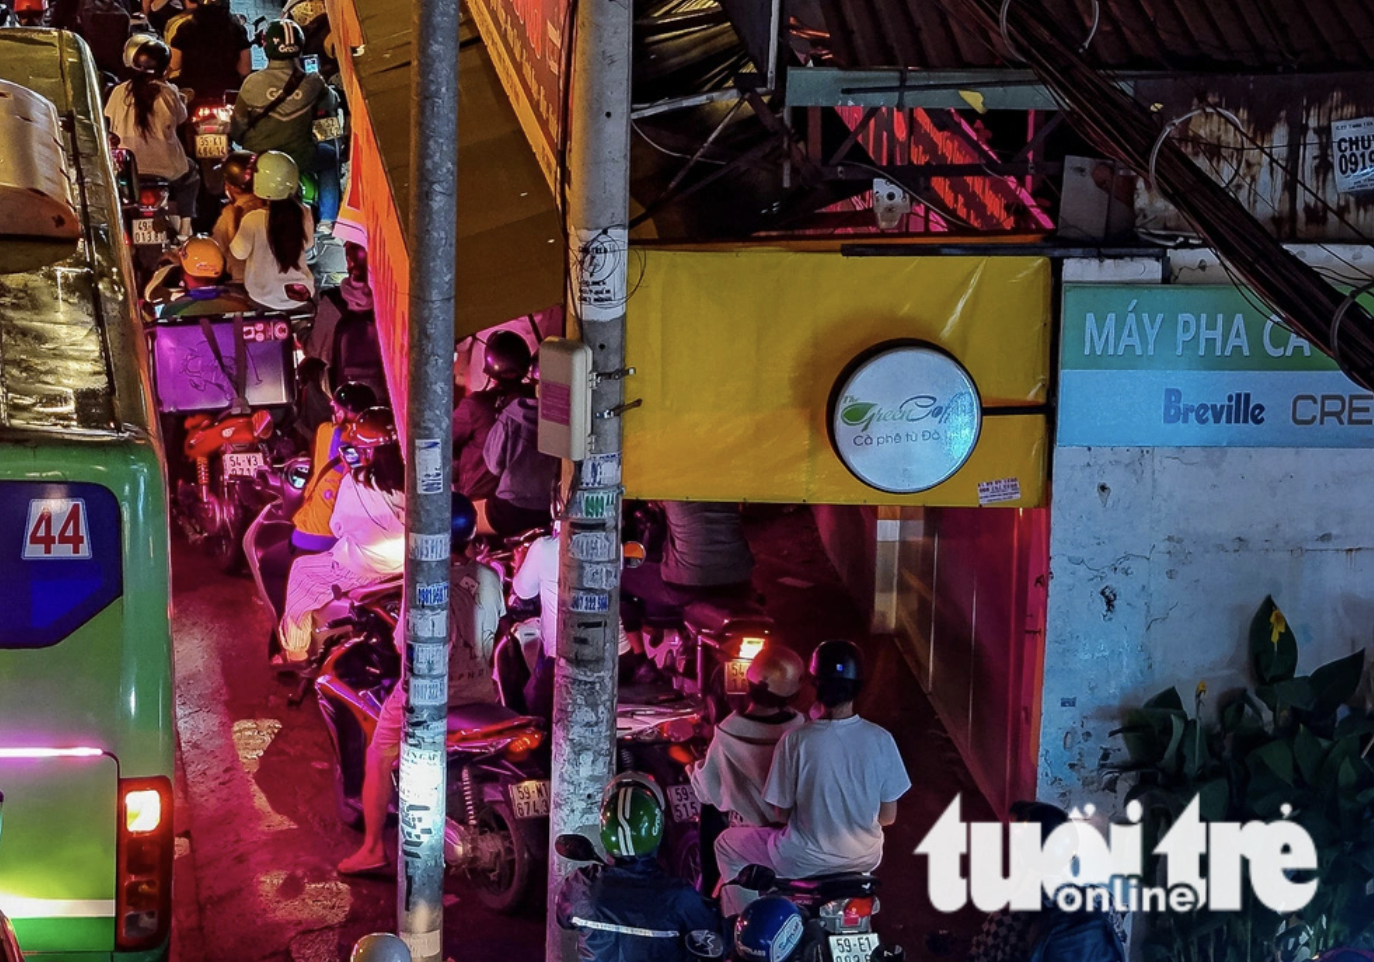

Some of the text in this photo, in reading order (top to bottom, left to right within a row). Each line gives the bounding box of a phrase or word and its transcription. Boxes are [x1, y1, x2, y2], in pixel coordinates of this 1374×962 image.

[1084, 299, 1164, 357] MÁY
[1175, 313, 1250, 357] PHA
[1163, 387, 1266, 426] Breville
[29, 503, 85, 555] 44
